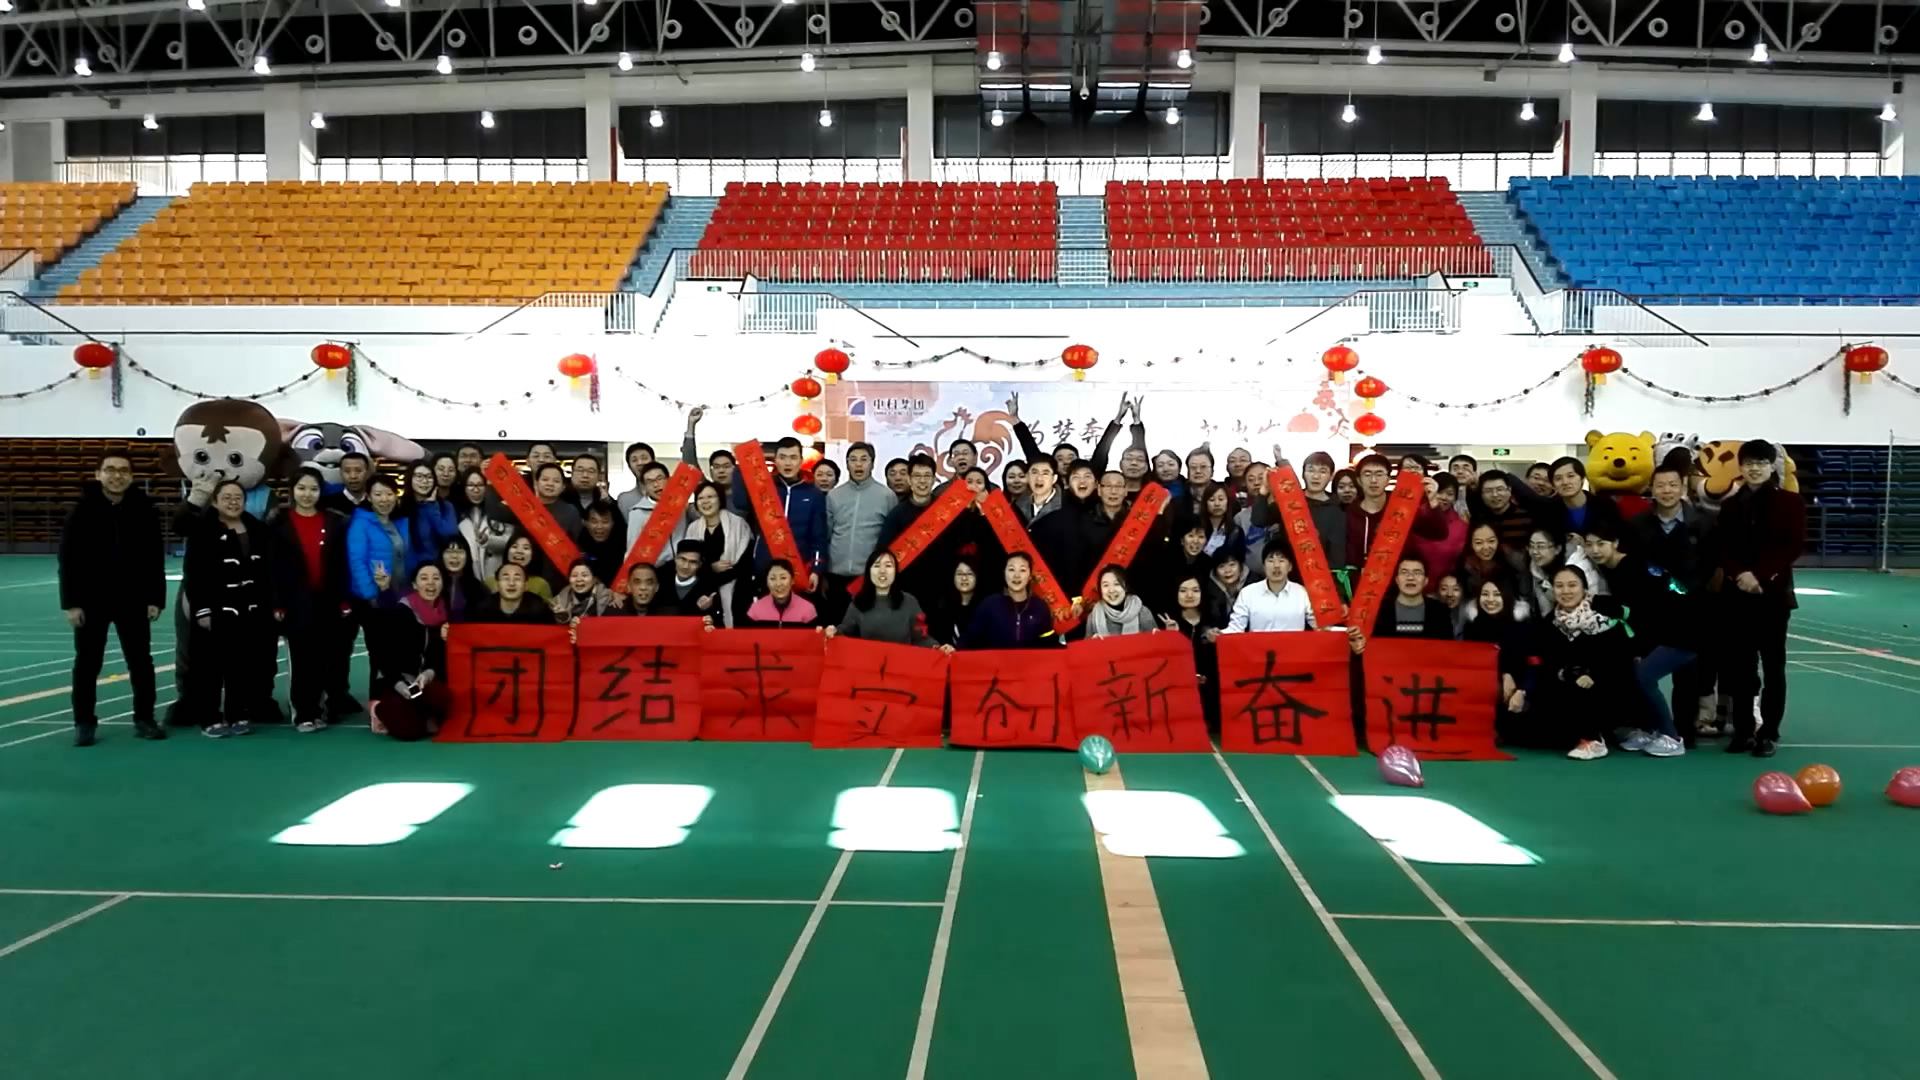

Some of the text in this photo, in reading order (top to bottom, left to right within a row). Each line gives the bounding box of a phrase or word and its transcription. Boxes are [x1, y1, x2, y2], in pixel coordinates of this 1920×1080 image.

[464, 643, 1473, 755] 团结求实创新奋进
